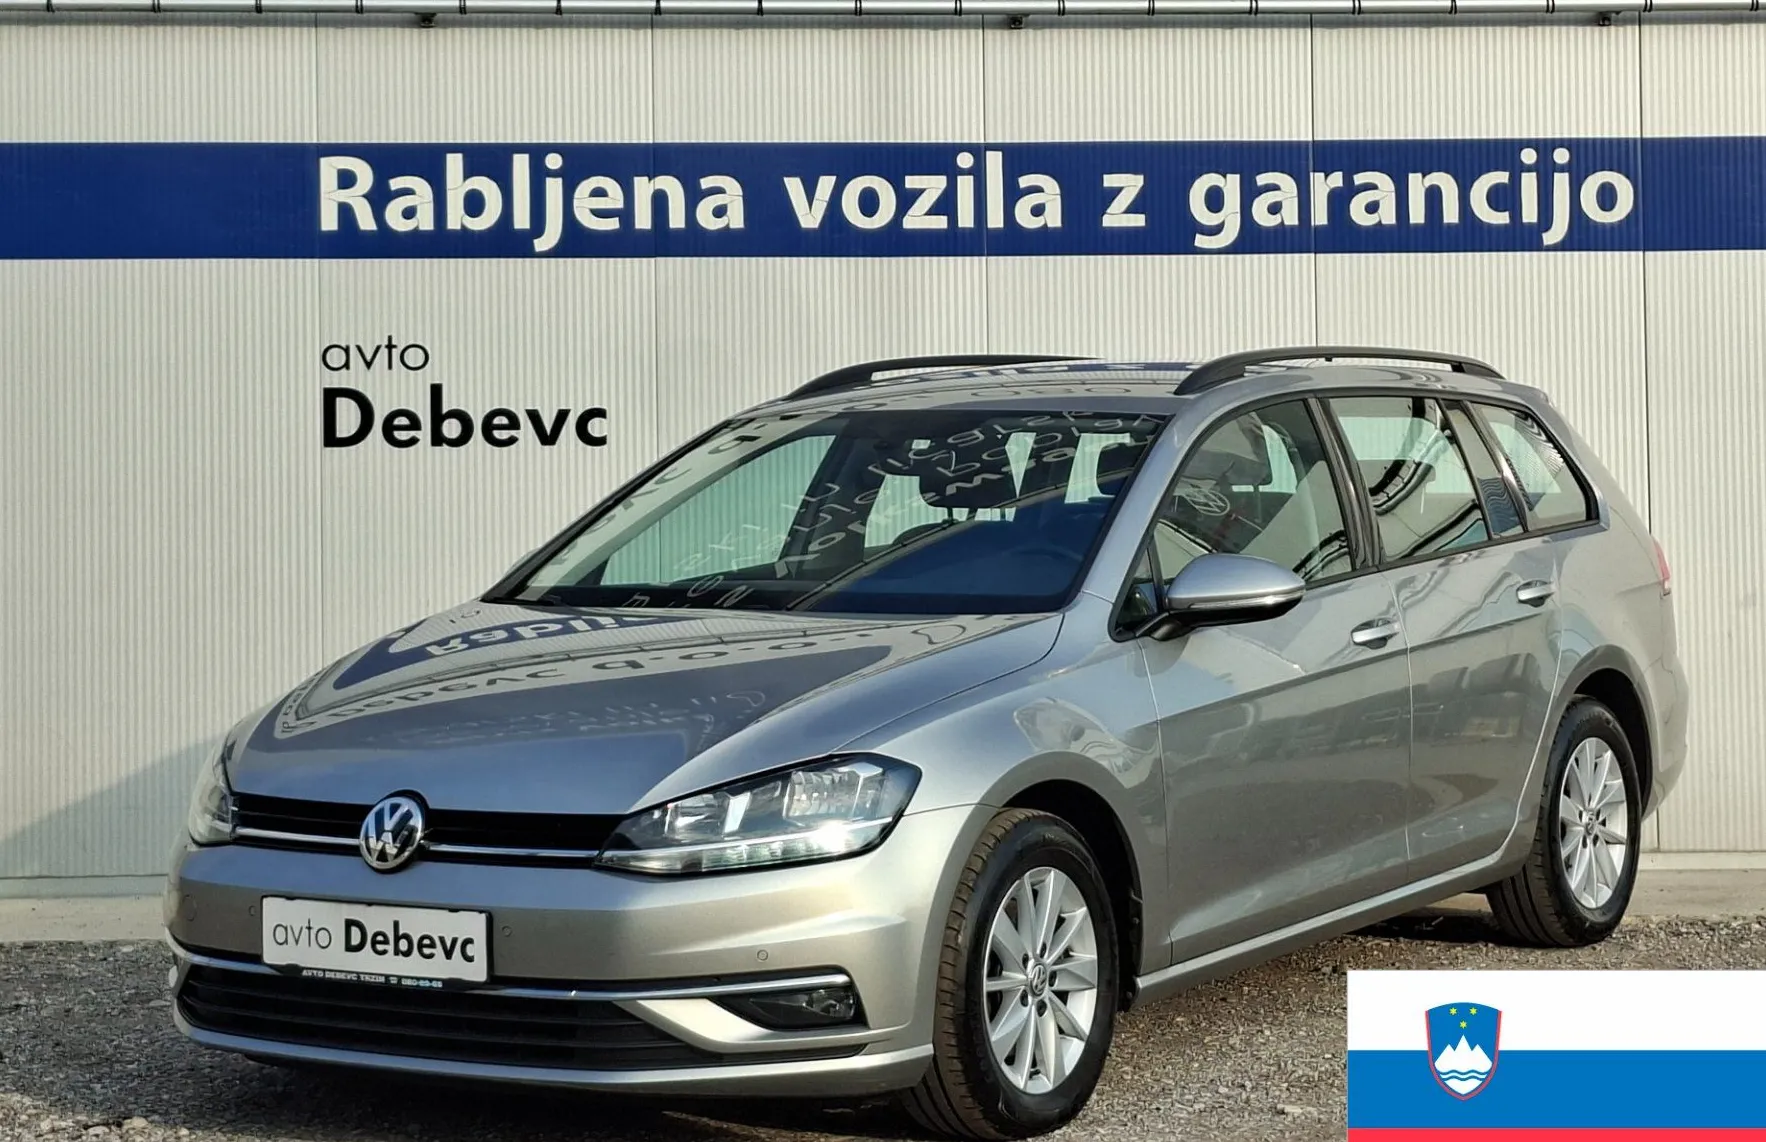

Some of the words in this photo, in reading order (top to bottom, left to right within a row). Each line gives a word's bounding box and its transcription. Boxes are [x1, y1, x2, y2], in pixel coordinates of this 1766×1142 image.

[319, 152, 745, 249] Rabljena
[783, 151, 1062, 230] vozila
[1102, 173, 1146, 228] z
[1189, 147, 1635, 249] garancijo
[321, 334, 430, 372] avto
[322, 382, 608, 449] Debevc
[272, 918, 332, 950] avto
[344, 918, 475, 963] Debevc
